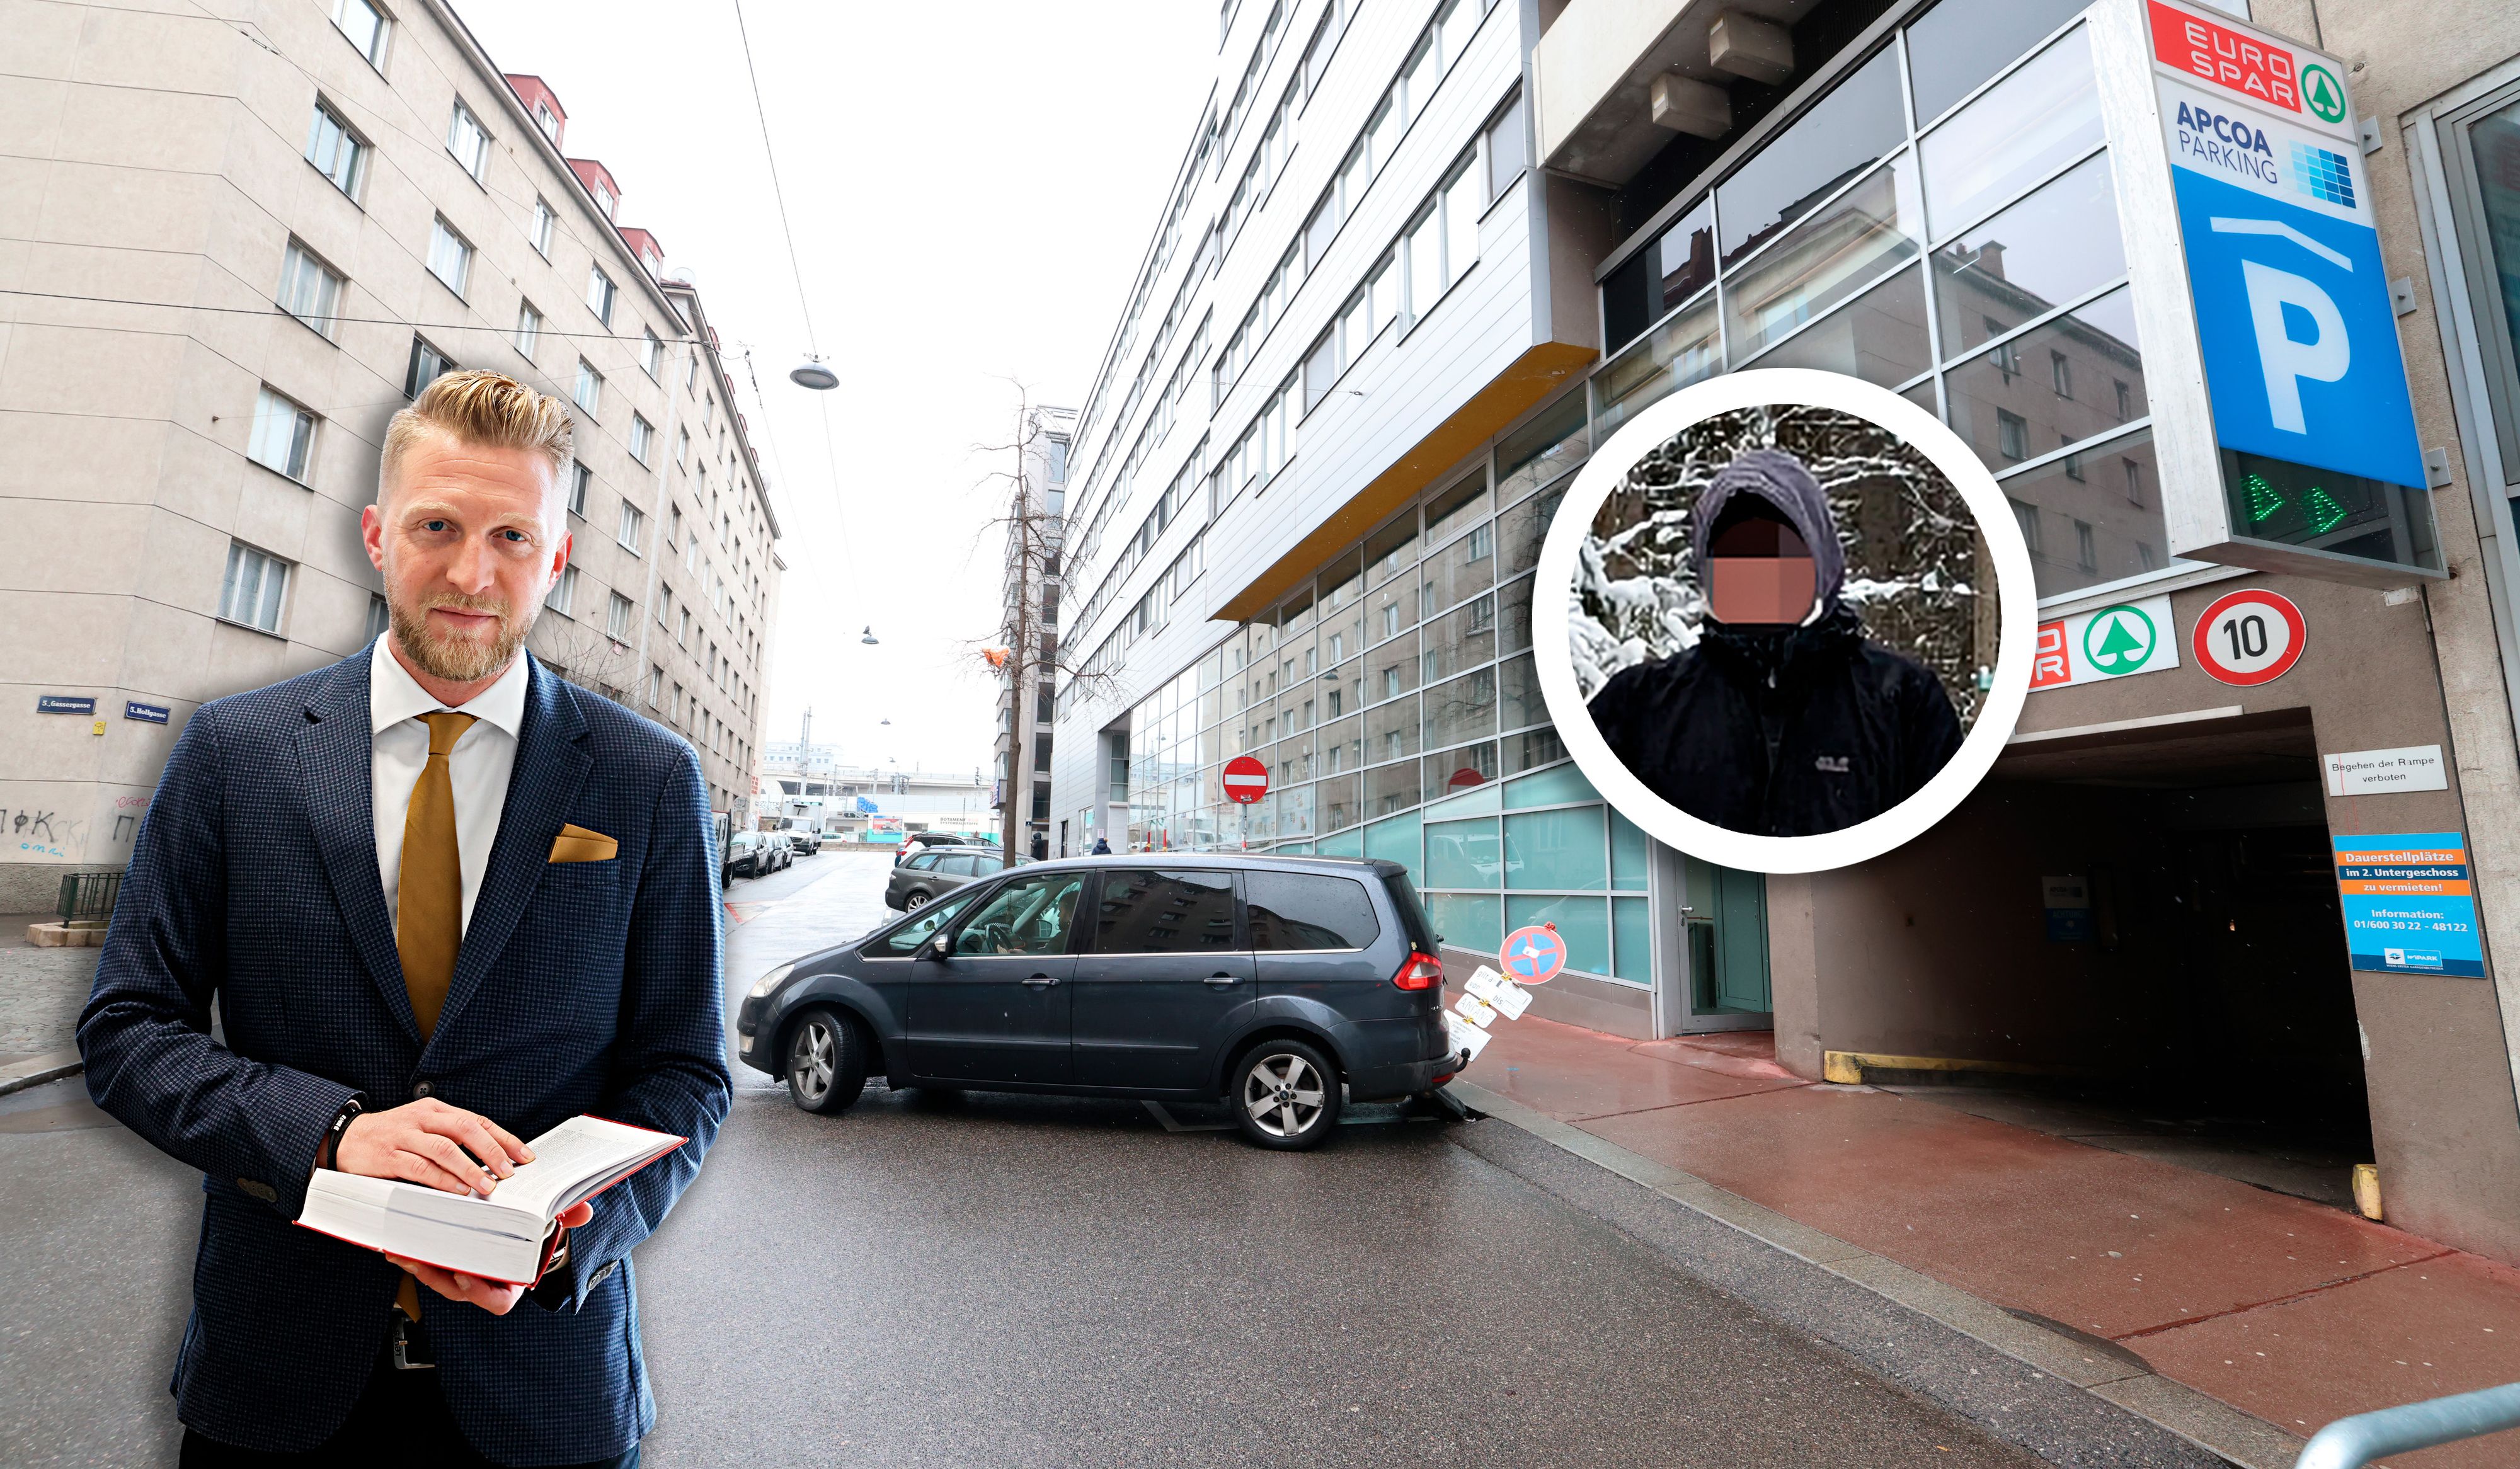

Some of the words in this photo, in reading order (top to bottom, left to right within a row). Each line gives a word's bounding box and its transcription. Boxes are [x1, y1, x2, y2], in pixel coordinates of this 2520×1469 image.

[2184, 21, 2291, 80] EURO
[2191, 50, 2295, 106] SPAR
[2177, 101, 2273, 157] APCOA
[2179, 130, 2277, 184] PARKING
[2241, 258, 2351, 435] P
[2223, 615, 2268, 660] 10
[50, 700, 91, 709] Gassergasse
[136, 707, 166, 719] Hollgasse
[2332, 762, 2374, 772] Begehen
[2398, 757, 2434, 767] Rampe
[2362, 774, 2406, 783] verboten
[2345, 852, 2454, 864] Dauerstellplätze
[2346, 869, 2360, 877] im
[2362, 869, 2373, 877] 2.
[2374, 868, 2459, 879] Untergeschoss
[2379, 883, 2443, 892] vermieten!
[2371, 909, 2444, 919] Information:
[2354, 920, 2390, 929] 01/600
[2393, 921, 2405, 930] 30
[2407, 922, 2422, 930] 22
[2432, 922, 2468, 932] 48122
[1492, 994, 1504, 1005] bis
